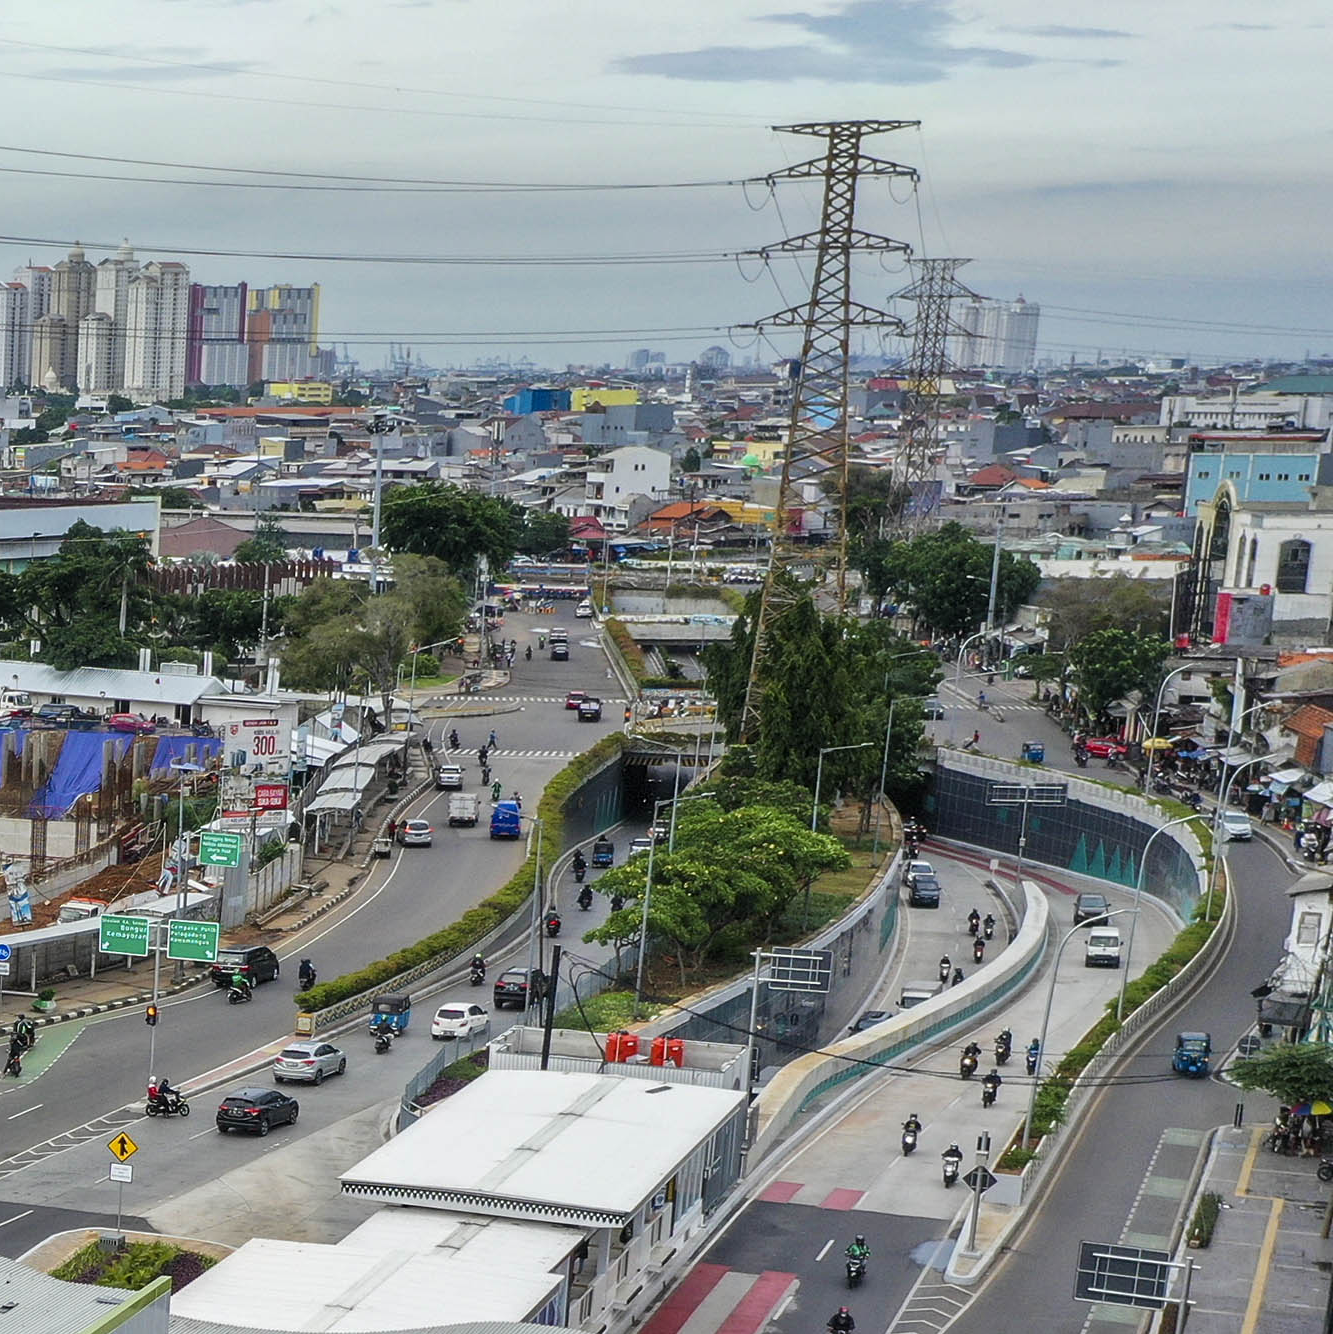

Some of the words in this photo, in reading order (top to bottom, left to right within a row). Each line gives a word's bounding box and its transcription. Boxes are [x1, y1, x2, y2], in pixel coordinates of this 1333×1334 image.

[253, 735, 275, 755] 300
[120, 925, 147, 933] Bungur
[106, 930, 147, 940] Kemayoran
